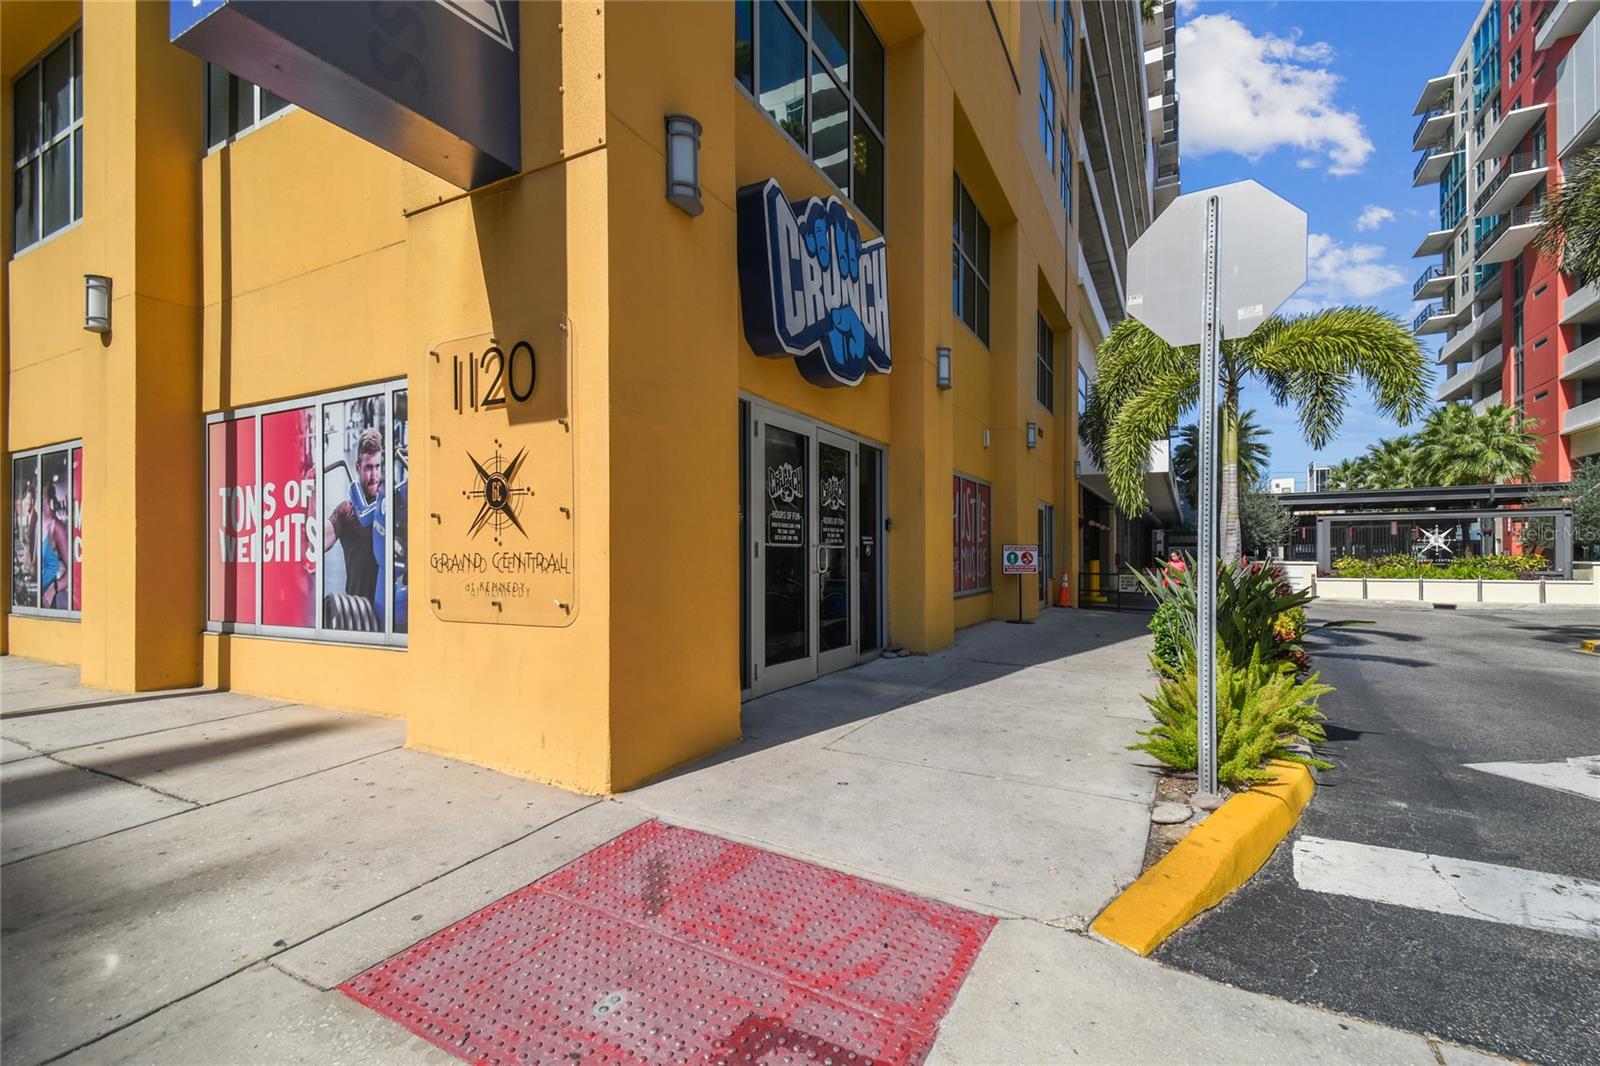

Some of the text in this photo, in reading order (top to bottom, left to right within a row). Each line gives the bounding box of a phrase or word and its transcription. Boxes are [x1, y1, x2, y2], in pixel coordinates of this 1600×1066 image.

[775, 192, 892, 360] CRUNCH
[453, 340, 536, 411] 1120
[219, 479, 315, 533] TONS OF
[219, 513, 319, 563] WEIGHTS
[430, 552, 567, 570] GRAND CENTRAL
[479, 581, 526, 593] KENNEDY
